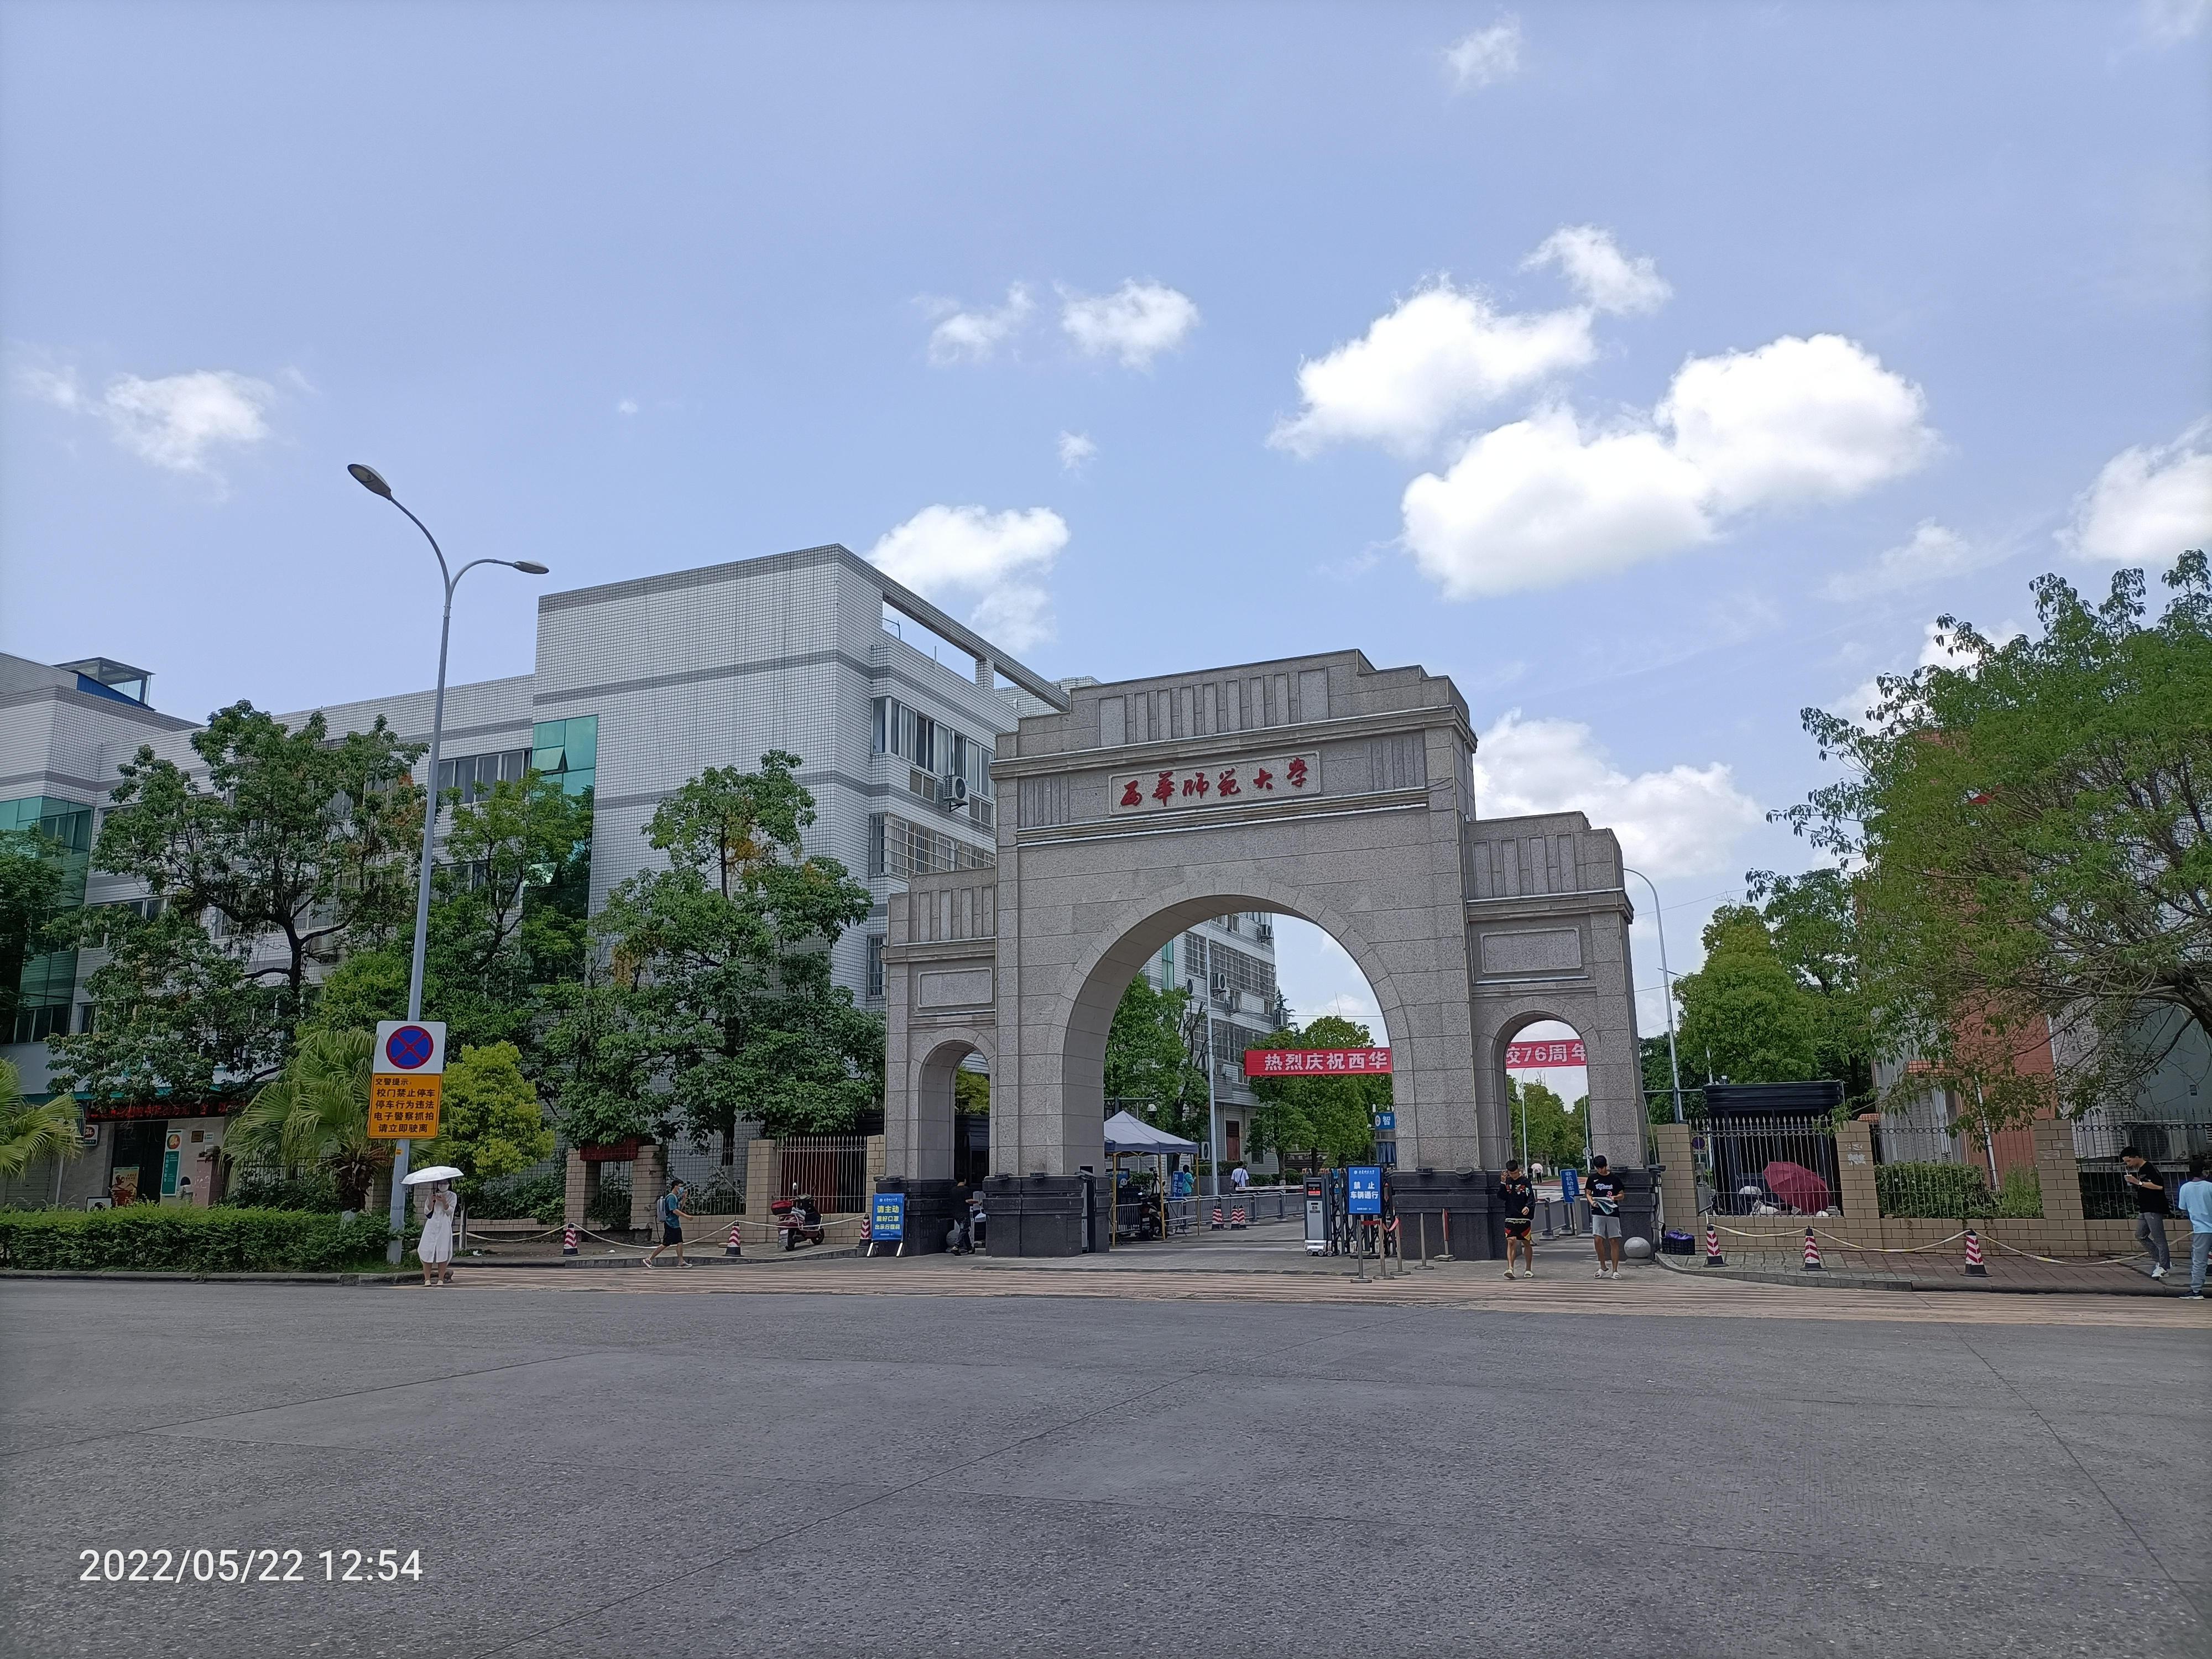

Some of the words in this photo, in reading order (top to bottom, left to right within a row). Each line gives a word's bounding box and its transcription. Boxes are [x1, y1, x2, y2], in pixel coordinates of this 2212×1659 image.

[1265, 1051, 1387, 1071] 热烈庆祝西华
[377, 1088, 435, 1098] 校门禁止停车
[375, 1100, 434, 1109] 停车行为违法
[374, 1112, 434, 1121] 电子警察抓拍
[1383, 1115, 1391, 1125] 智
[378, 1124, 428, 1133] 请立即驶离
[1353, 1181, 1375, 1189] 禁止
[1350, 1191, 1379, 1199] 车辆通行
[877, 1205, 899, 1213] 请主动
